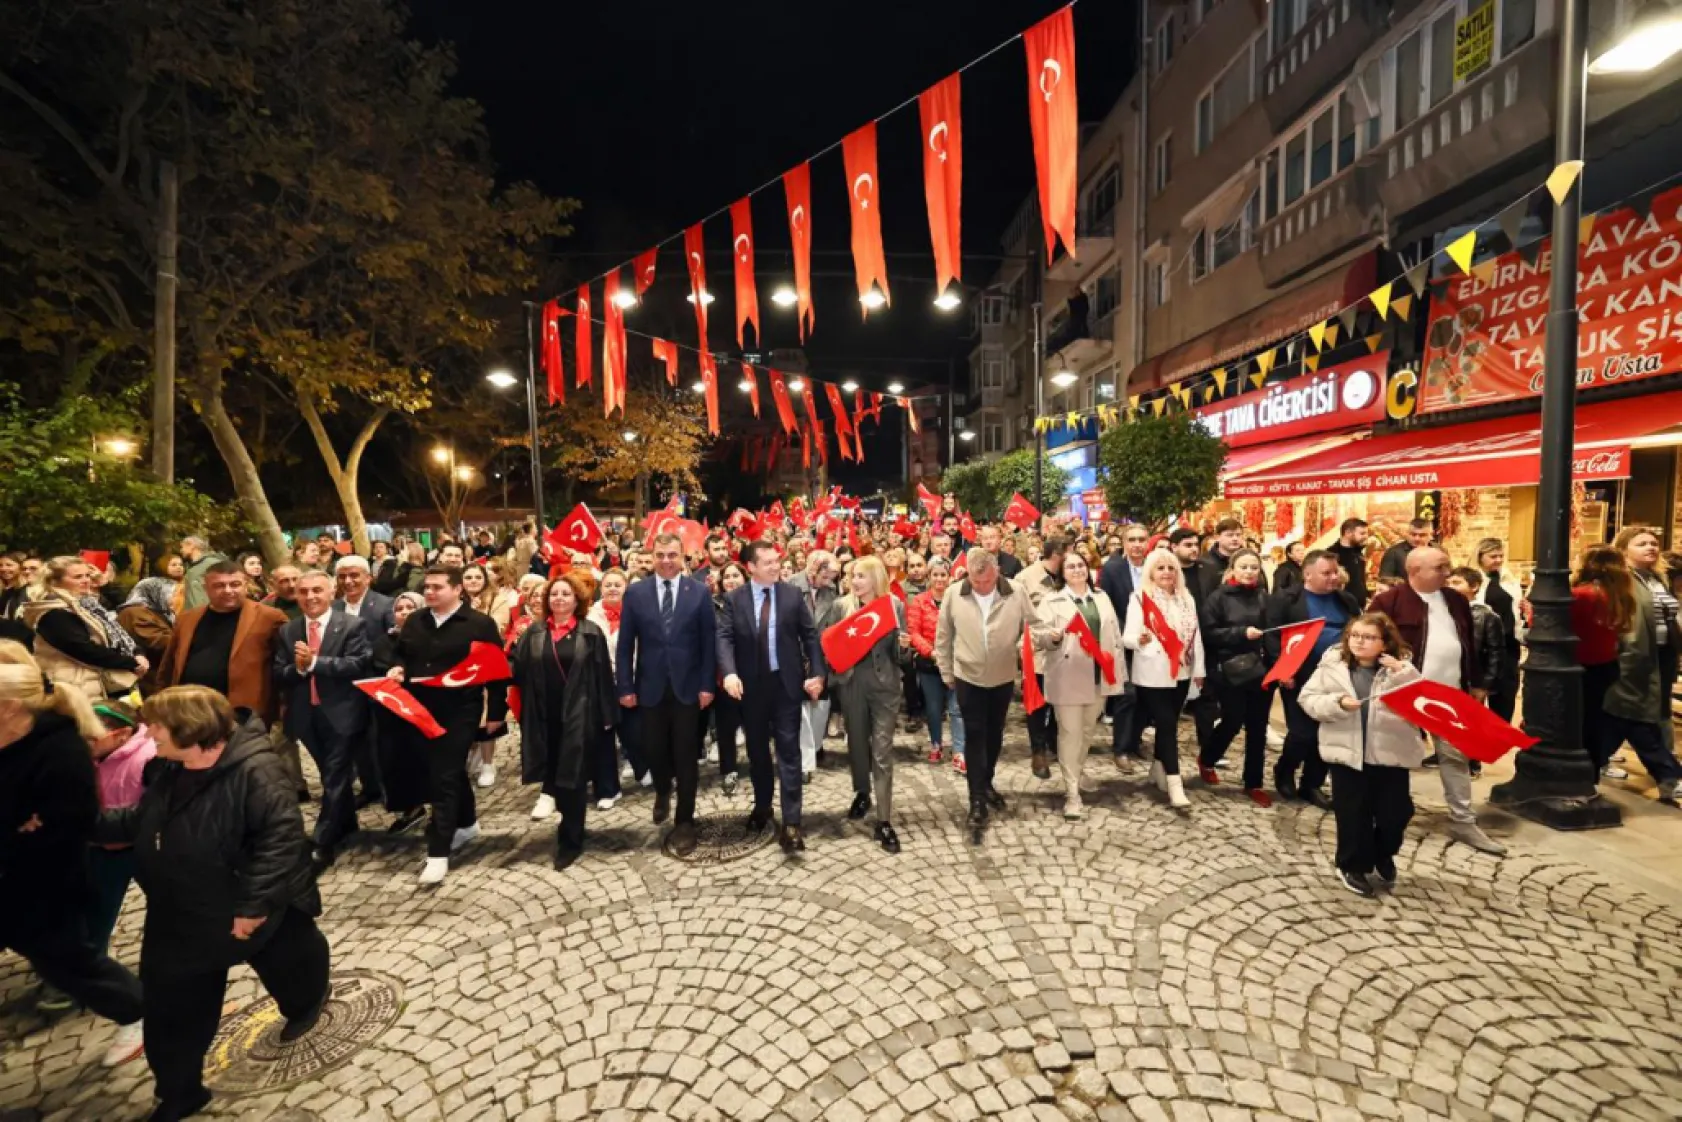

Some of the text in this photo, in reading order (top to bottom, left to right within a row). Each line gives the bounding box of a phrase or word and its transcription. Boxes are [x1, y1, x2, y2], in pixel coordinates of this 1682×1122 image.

[1583, 212, 1661, 258] AVA
[1488, 299, 1594, 345] TAVK
[1510, 325, 1624, 370] TAUK
[1603, 351, 1662, 380] Usta
[1225, 402, 1256, 436] TAVA
[1259, 372, 1336, 428] CİĞERCİSİ
[1375, 473, 1407, 488] CİHAN
[1409, 472, 1439, 485] USTA
